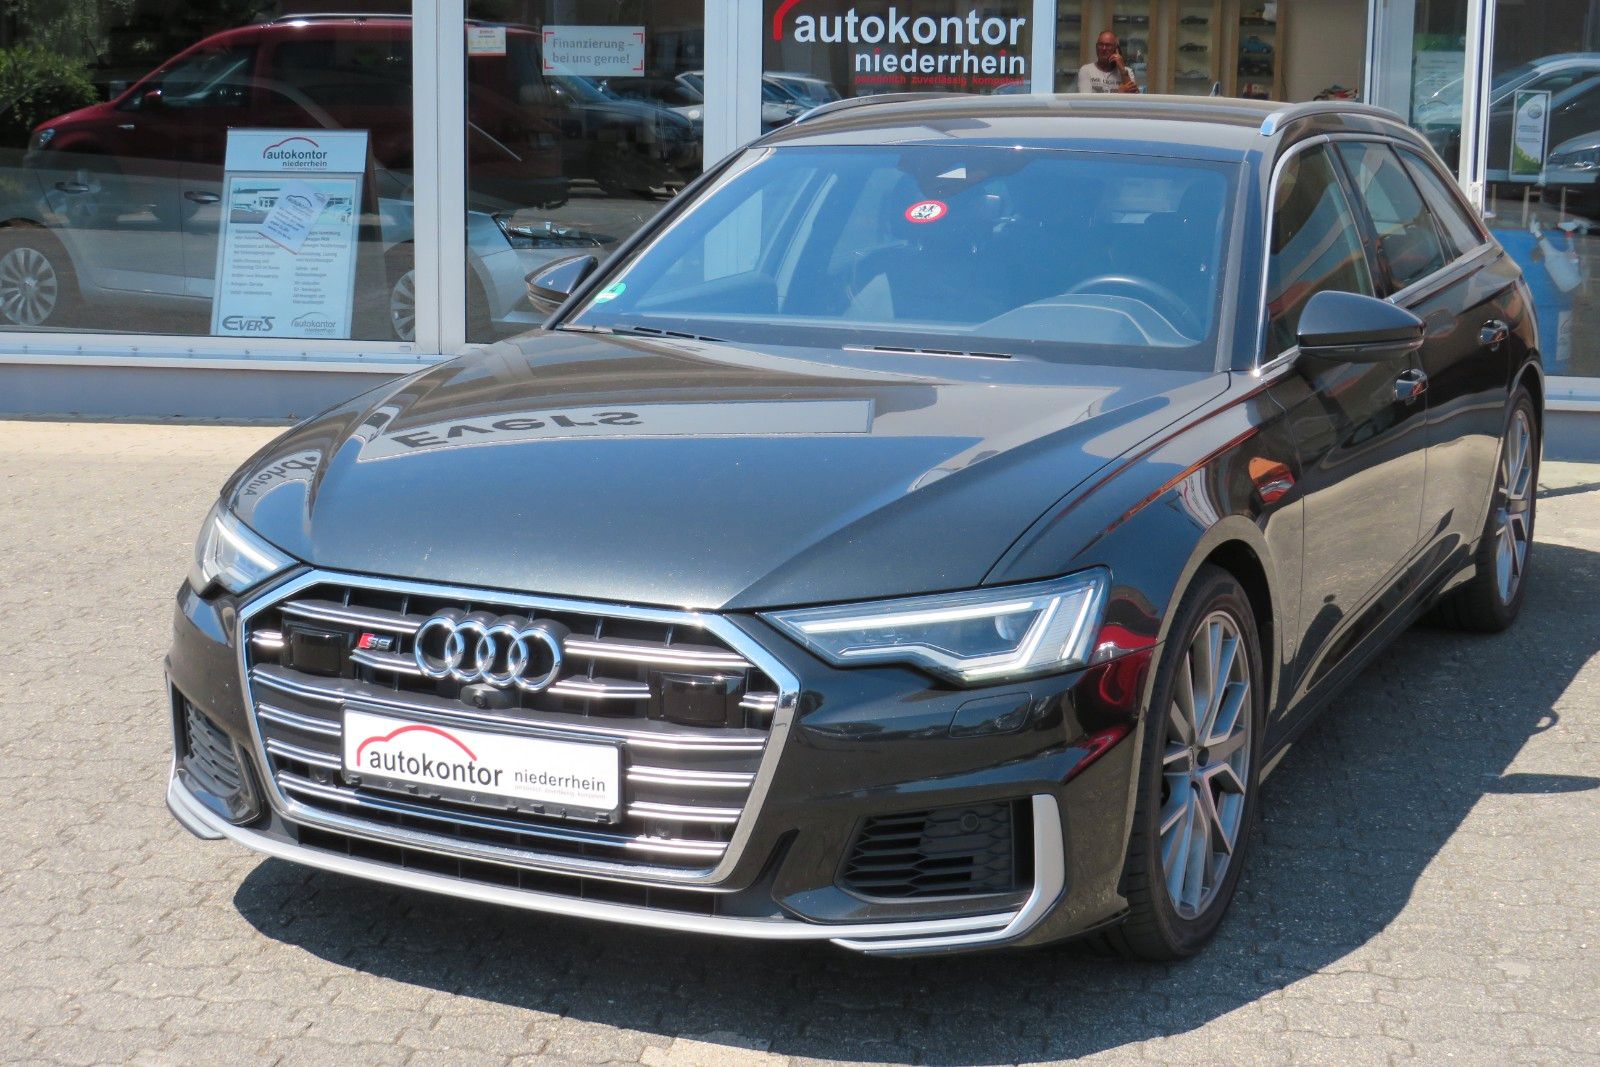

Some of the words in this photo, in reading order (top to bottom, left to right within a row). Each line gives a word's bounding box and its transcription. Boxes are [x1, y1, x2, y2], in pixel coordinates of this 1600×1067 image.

[794, 7, 1026, 45] autokontor
[552, 38, 625, 51] Finanzierung
[552, 53, 569, 64] bei
[572, 55, 592, 64] uns
[594, 54, 630, 66] gerne!
[855, 48, 1025, 75] niederrhein
[266, 149, 328, 160] autokontor
[369, 749, 504, 787] autokontor
[514, 768, 606, 793] niederrhein
